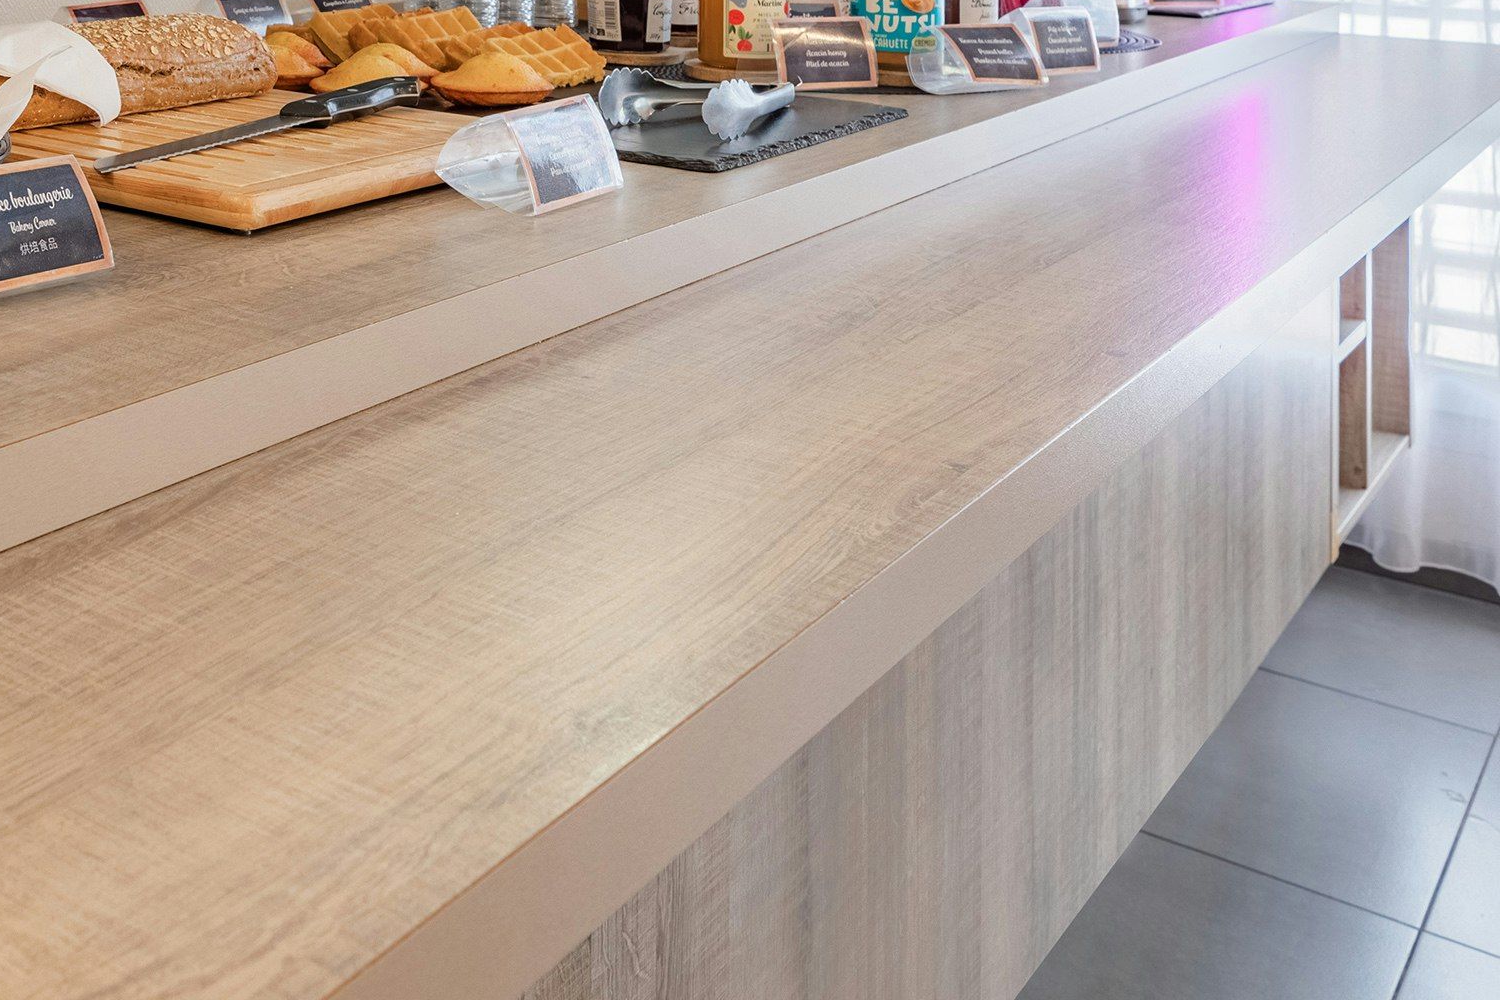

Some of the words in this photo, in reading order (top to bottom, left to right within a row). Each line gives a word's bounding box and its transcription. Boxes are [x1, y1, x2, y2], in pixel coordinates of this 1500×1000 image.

[10, 186, 74, 210] boulangerie
[8, 219, 34, 235] Bakery
[33, 216, 57, 231] Corner
